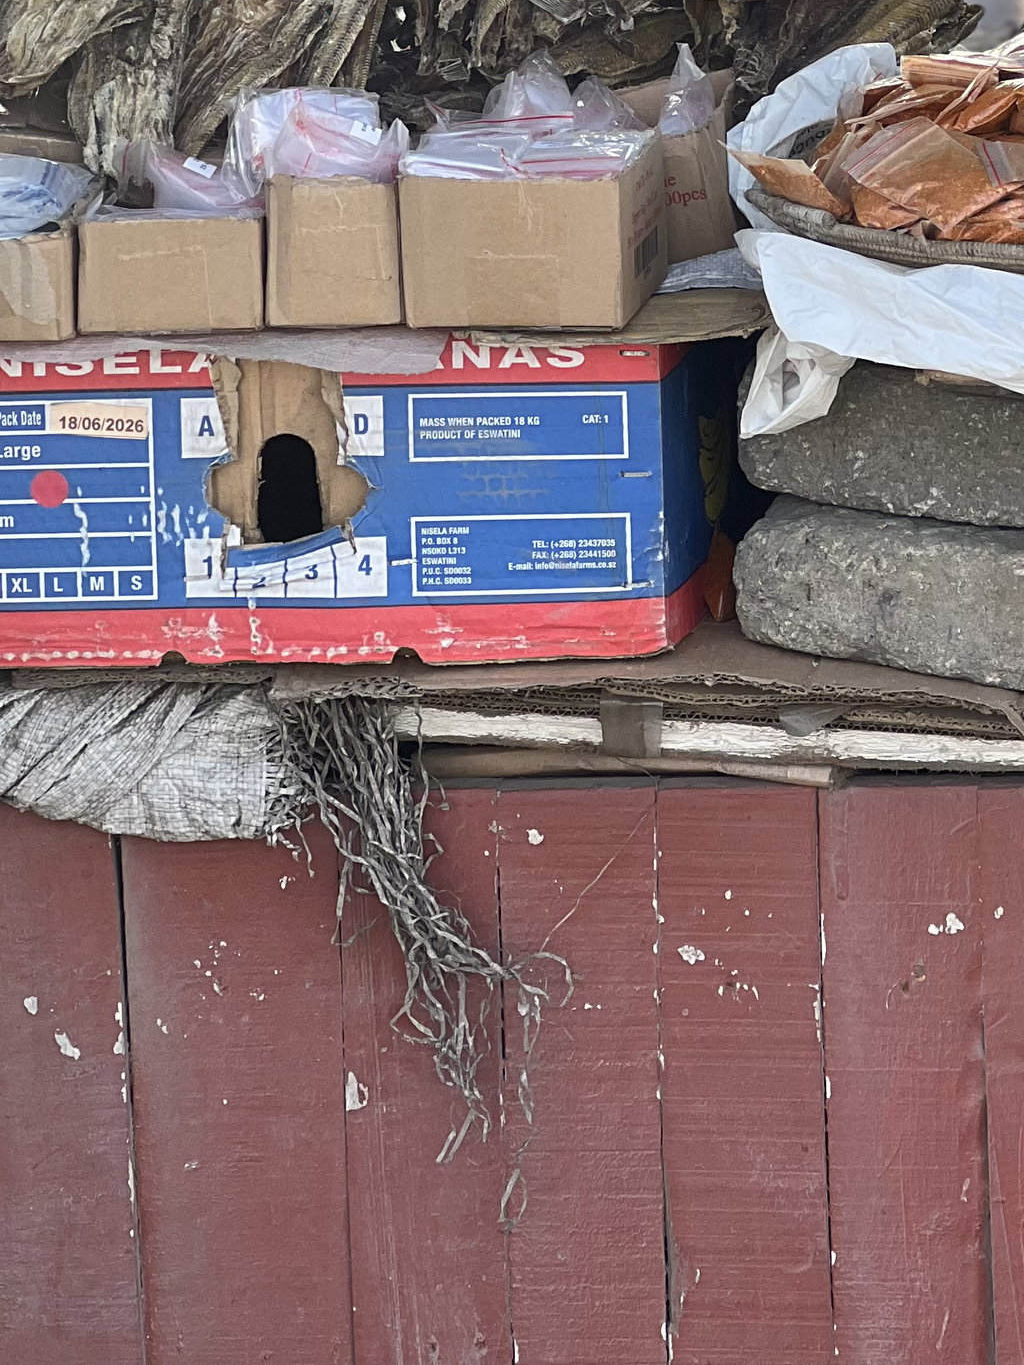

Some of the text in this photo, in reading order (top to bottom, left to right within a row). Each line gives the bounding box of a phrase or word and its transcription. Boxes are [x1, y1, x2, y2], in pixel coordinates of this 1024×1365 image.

[0, 410, 42, 427] ack Date
[420, 416, 540, 428] MASS WHEN PACKED 18 KG
[582, 414, 609, 424] CAT: 1
[58, 416, 144, 433] 18/06/2026
[198, 414, 368, 437] A D
[420, 429, 521, 440] PRODUCT OF ESWATINI
[0, 445, 42, 462] arge
[421, 526, 470, 535] NISELA FARM
[421, 537, 436, 545] P.O.
[436, 537, 452, 545] BOX
[532, 539, 616, 549] TEL: (+268) 23437035
[422, 546, 466, 555] NSOKO L313
[532, 550, 616, 560] FAX: (+268) 23441500
[422, 557, 457, 565] ESWATINI
[508, 562, 534, 570] E-mail:
[202, 556, 212, 579] 1
[304, 564, 319, 580] 3
[358, 554, 373, 576] 4
[422, 567, 443, 576] P.U.C.
[11, 575, 142, 593] XL L M S
[422, 577, 443, 586] P.H.C.
